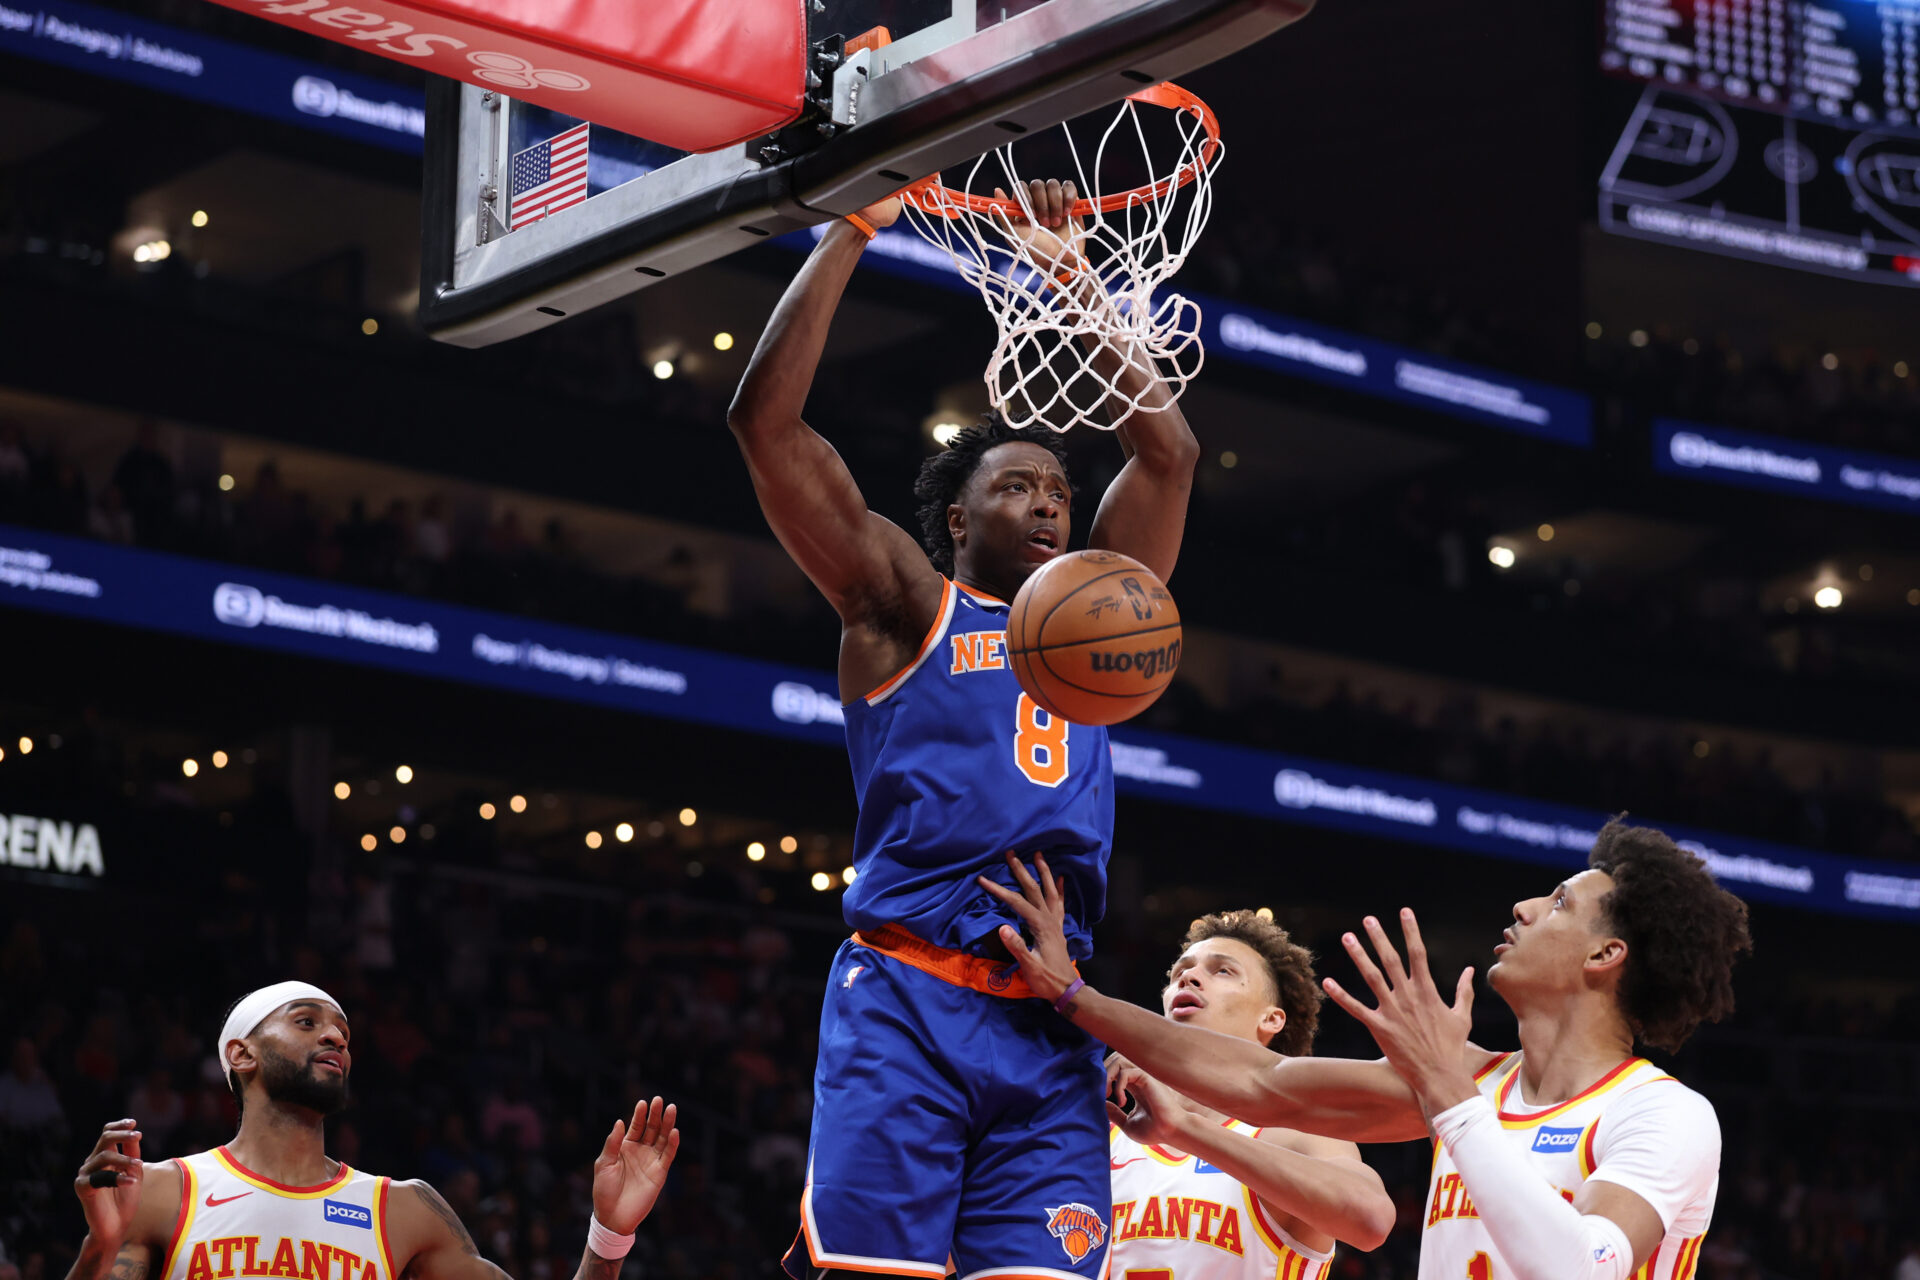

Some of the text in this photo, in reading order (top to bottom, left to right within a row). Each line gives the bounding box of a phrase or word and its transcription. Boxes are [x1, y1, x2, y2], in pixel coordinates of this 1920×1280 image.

[256, 0, 467, 56] Stat
[950, 630, 1013, 676] NE
[1090, 638, 1181, 680] Wilson
[1014, 691, 1069, 788] 8
[1536, 1132, 1580, 1147] paze
[327, 1203, 369, 1223] paze
[1050, 1207, 1103, 1244] KNICKS
[1112, 1196, 1244, 1258] TLANTA
